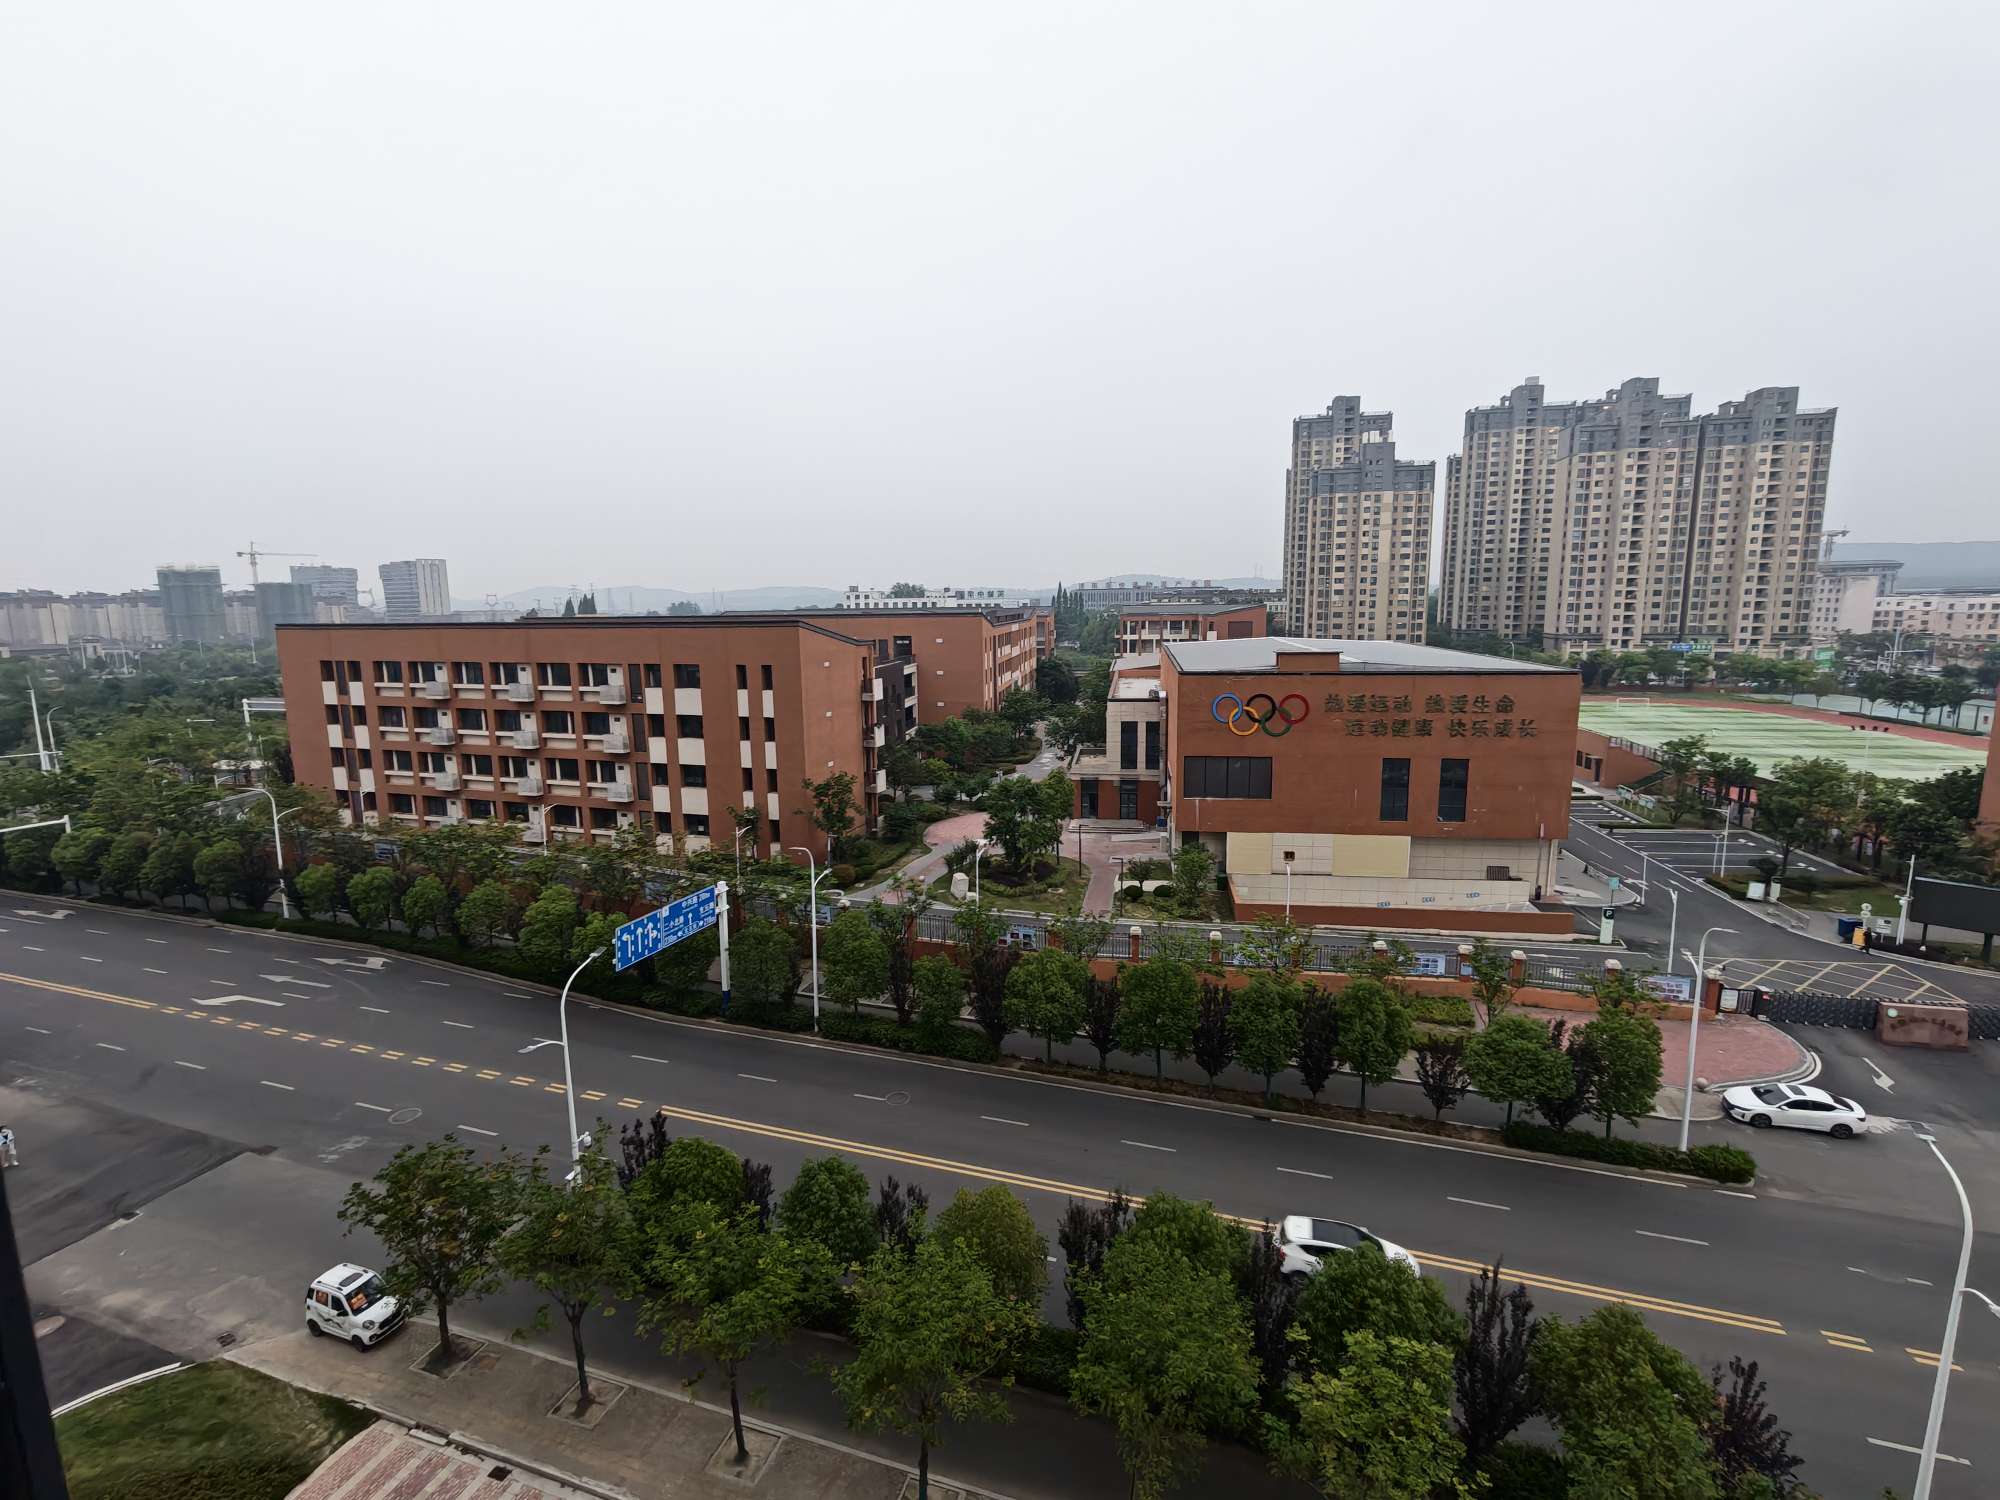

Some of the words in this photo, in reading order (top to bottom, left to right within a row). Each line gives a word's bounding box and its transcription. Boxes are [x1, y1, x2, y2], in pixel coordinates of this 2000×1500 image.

[1324, 694, 1413, 713] 热爱运动
[1424, 694, 1515, 714] 热爱生命
